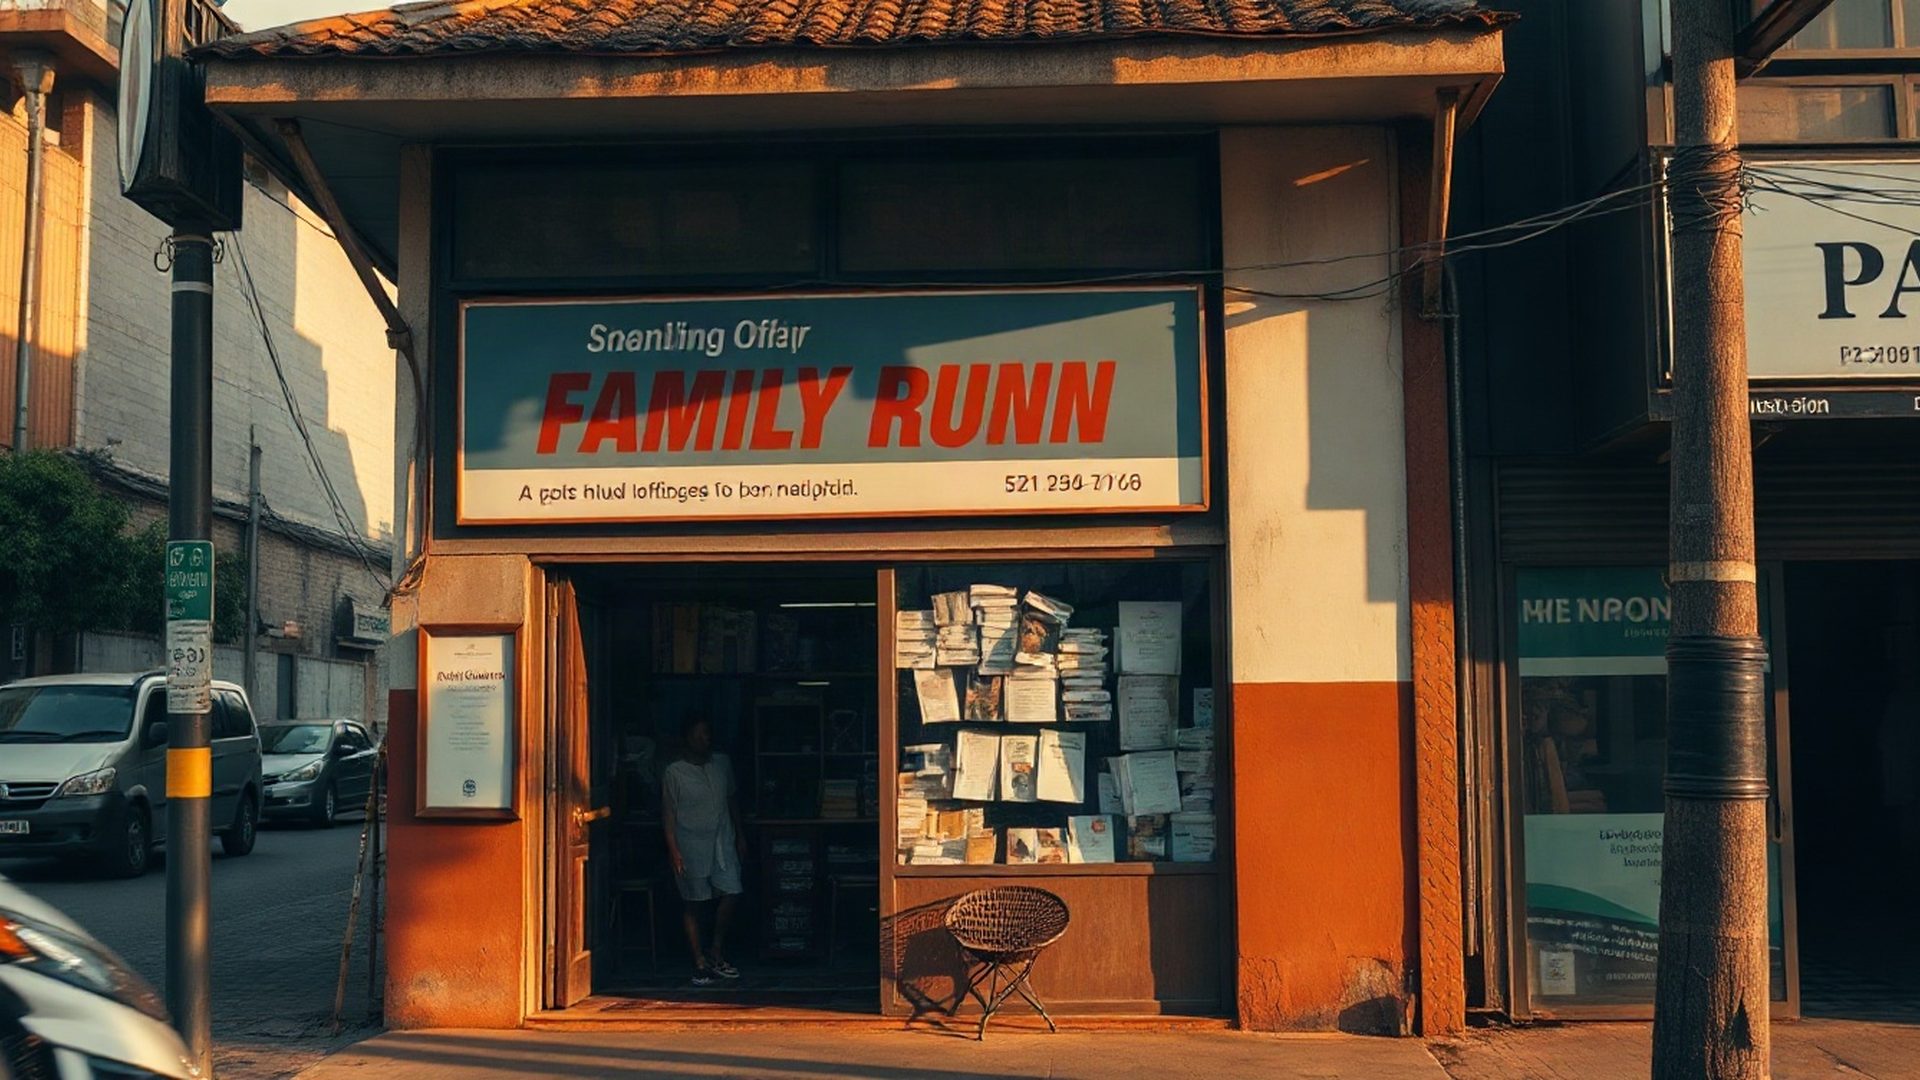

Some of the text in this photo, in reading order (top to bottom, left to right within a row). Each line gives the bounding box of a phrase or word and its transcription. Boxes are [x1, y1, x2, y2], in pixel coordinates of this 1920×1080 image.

[536, 361, 1116, 454] FAMILY RUNN
[1005, 475, 1037, 492] 521
[518, 485, 533, 500] A
